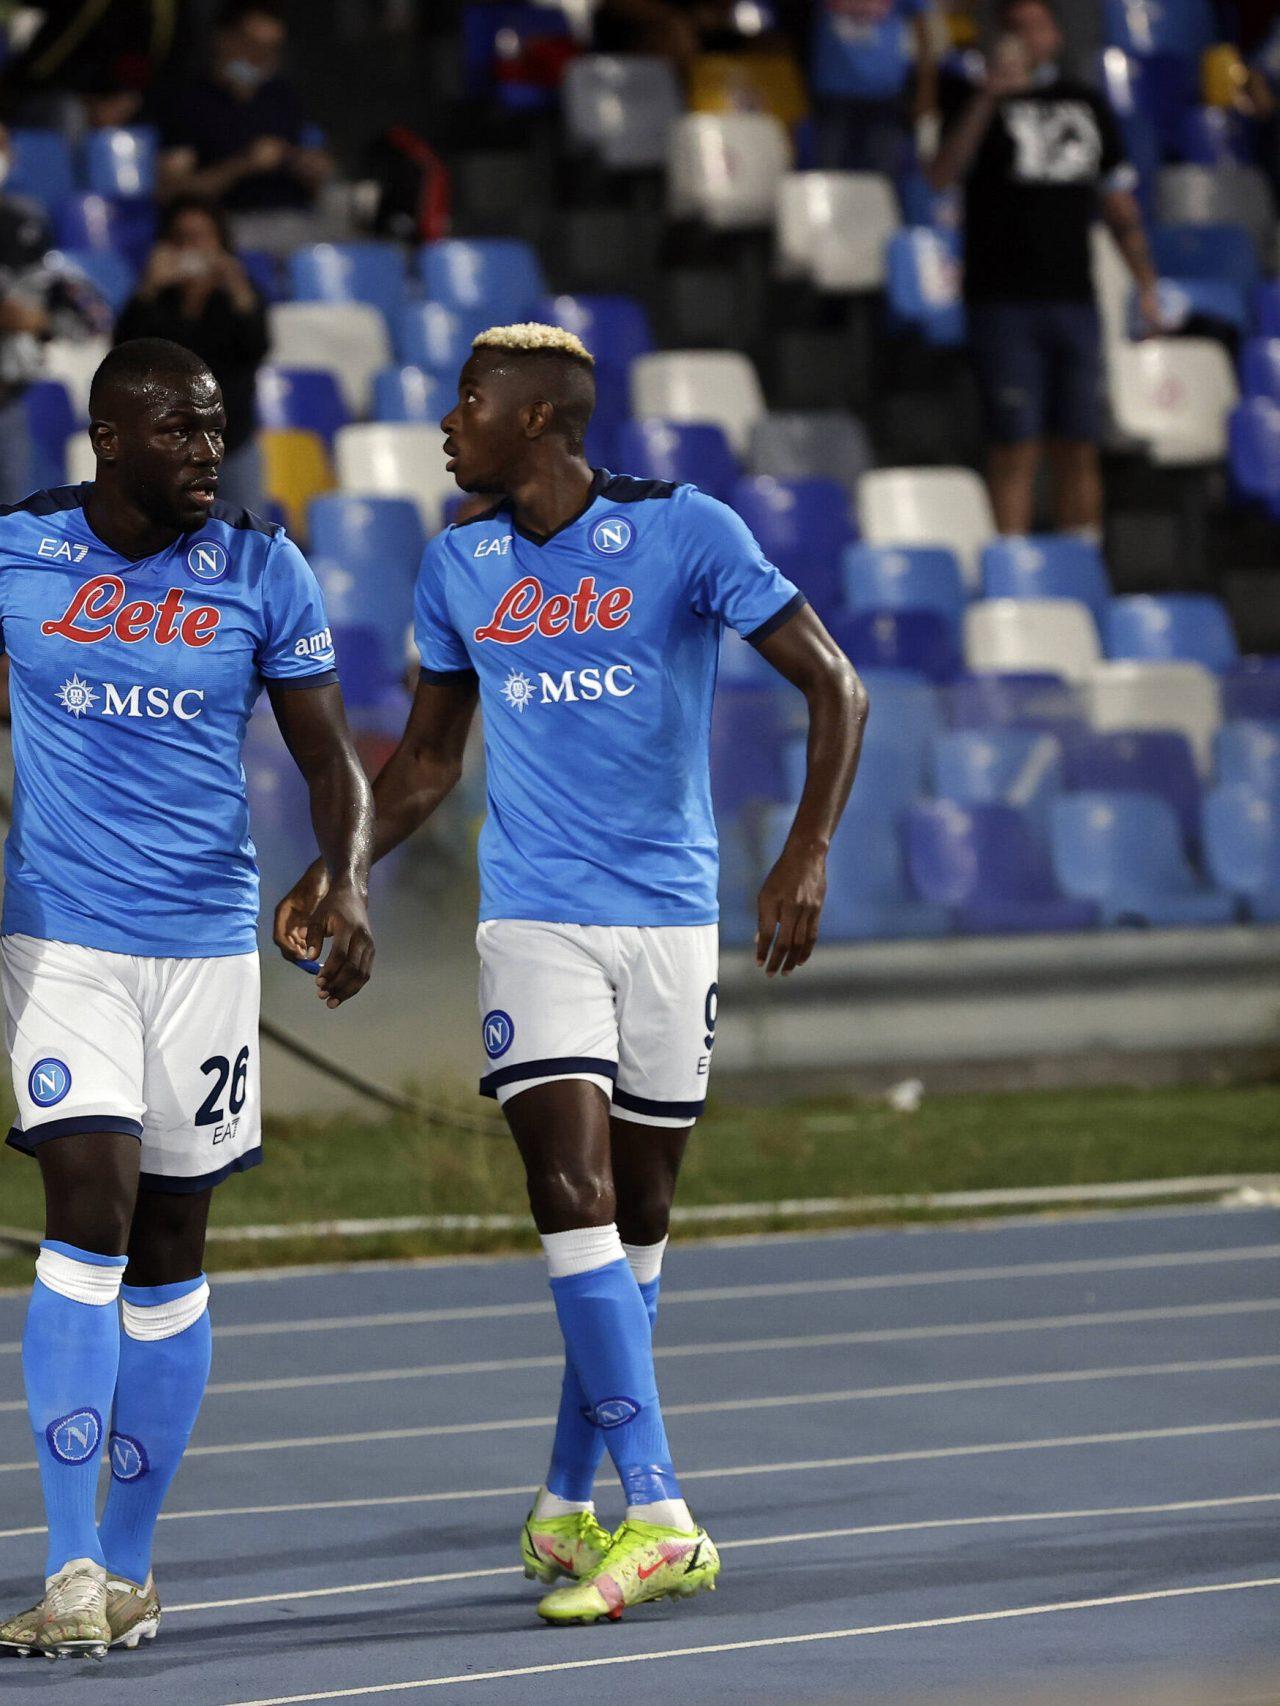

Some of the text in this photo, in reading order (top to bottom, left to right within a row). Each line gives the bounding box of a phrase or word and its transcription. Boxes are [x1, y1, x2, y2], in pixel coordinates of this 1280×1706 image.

[37, 537, 89, 563] EA7
[41, 574, 221, 648] Lete
[473, 576, 633, 645] Lete
[101, 682, 205, 720] MSC
[538, 664, 636, 704] MSC
[195, 1045, 249, 1126] 26
[212, 1117, 240, 1145] EA7
